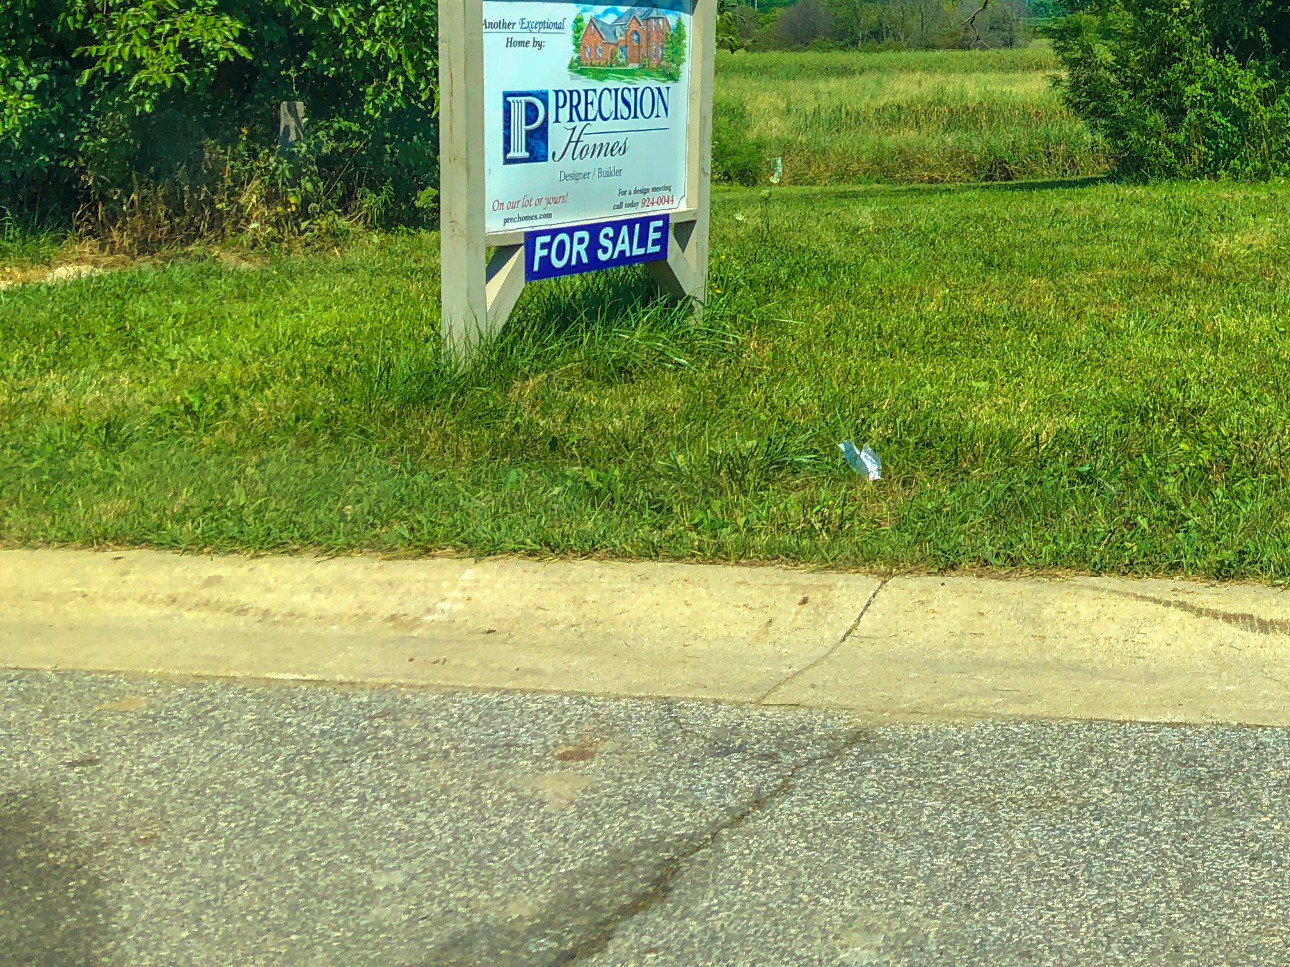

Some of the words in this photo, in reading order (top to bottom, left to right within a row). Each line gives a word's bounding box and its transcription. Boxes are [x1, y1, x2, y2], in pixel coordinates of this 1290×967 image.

[519, 17, 566, 33] Exceptional
[506, 37, 530, 48] Home
[532, 37, 546, 50] by:
[552, 86, 671, 124] PRECISION
[506, 96, 546, 160] P
[551, 123, 629, 162] Homes
[559, 170, 591, 183] Designer
[598, 166, 623, 178] Builder
[618, 189, 628, 197] For
[633, 187, 650, 195] design
[651, 184, 672, 193] meeting
[492, 199, 504, 212] On
[507, 200, 520, 210] our
[522, 195, 532, 208] lot
[534, 197, 543, 206] or
[543, 192, 569, 210] yours!
[613, 201, 623, 210] call
[624, 200, 640, 209] today
[641, 195, 674, 208] 924-0044
[503, 212, 553, 226] prechomes.com
[533, 230, 590, 273] FOR
[597, 220, 664, 262] SALE
